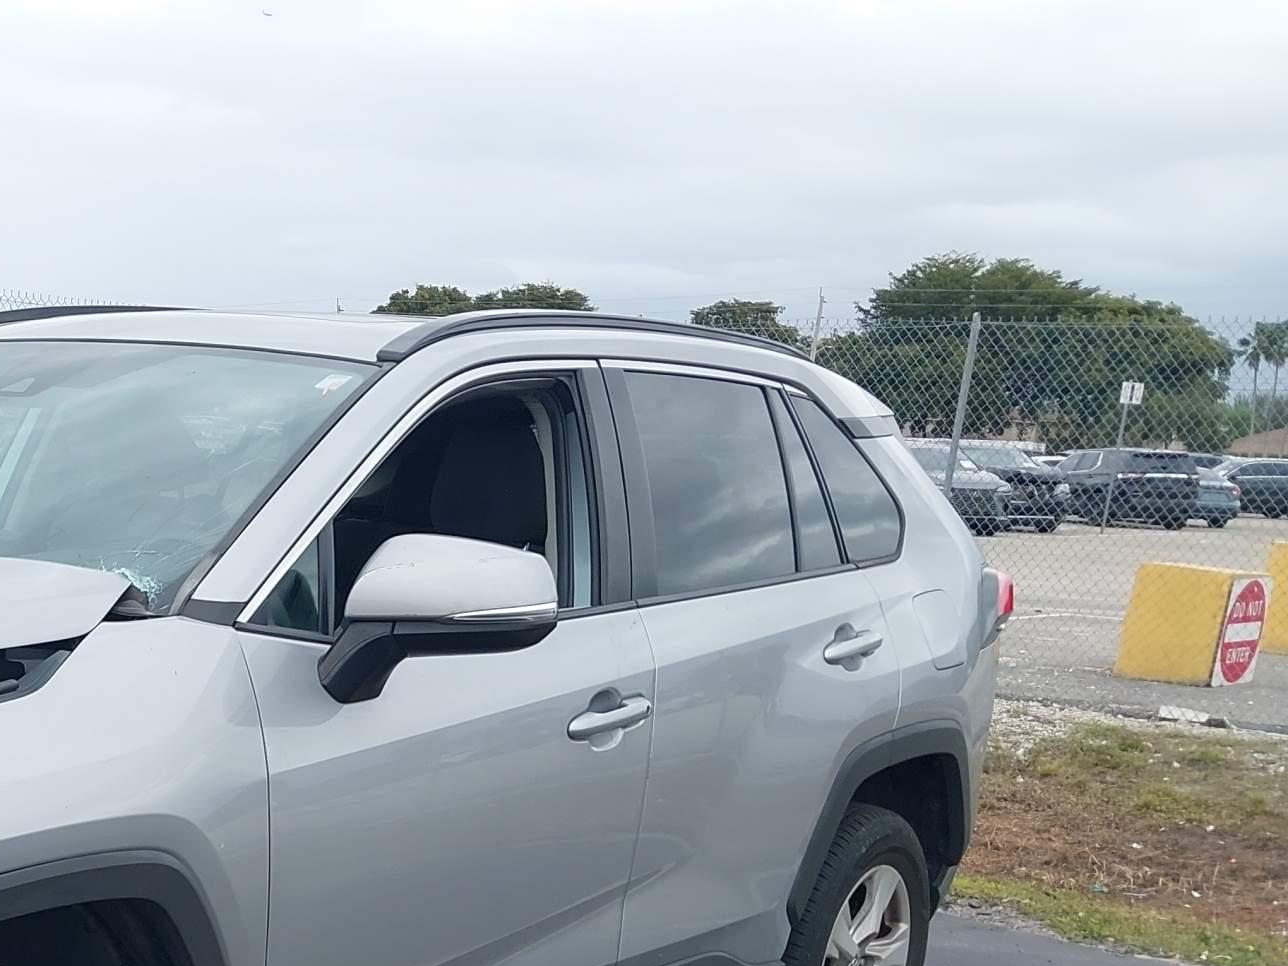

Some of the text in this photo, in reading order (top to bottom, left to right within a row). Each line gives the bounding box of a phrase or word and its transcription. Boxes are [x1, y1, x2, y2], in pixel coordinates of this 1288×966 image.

[1233, 600, 1263, 618] DO NOT
[1225, 647, 1251, 664] ENTER
